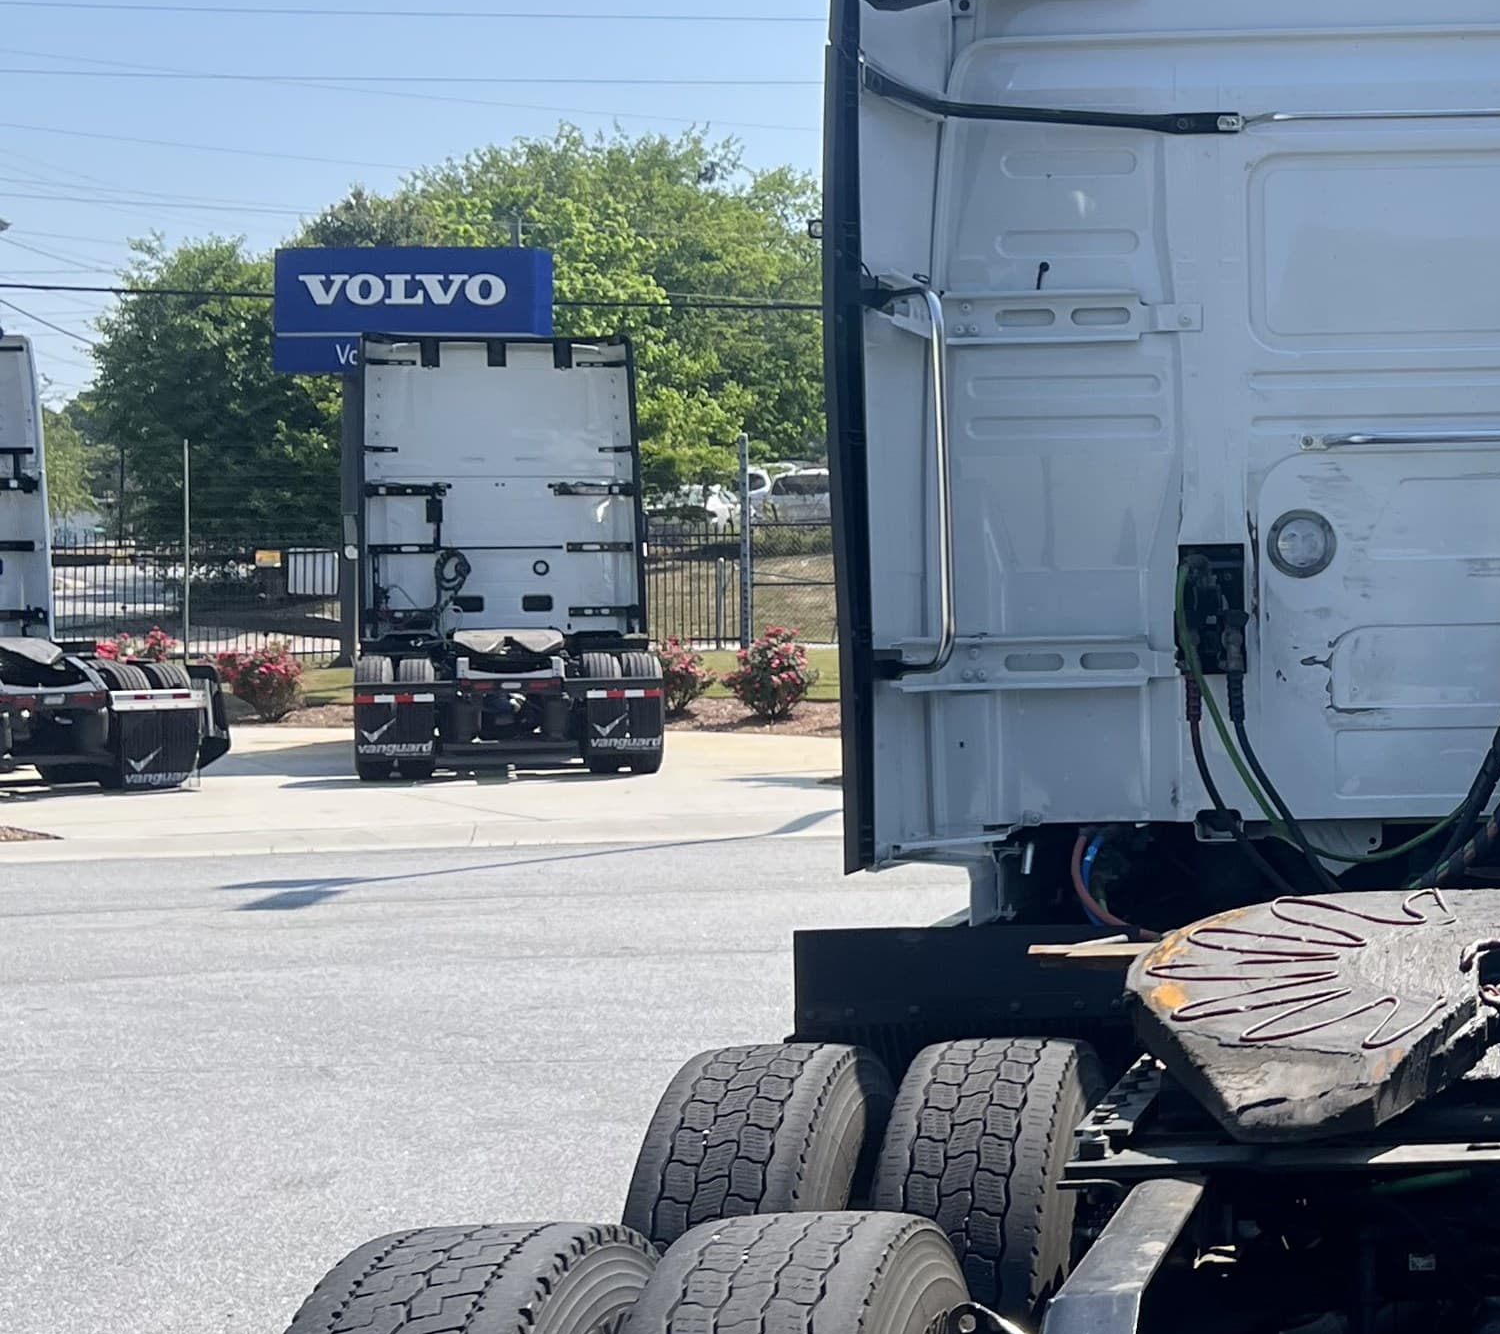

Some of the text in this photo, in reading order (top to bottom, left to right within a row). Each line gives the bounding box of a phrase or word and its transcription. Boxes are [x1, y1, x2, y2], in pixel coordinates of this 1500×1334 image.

[298, 273, 507, 306] VOLVO
[357, 740, 433, 756] vanguard
[590, 735, 662, 750] vanguard
[125, 772, 190, 786] vanguar
